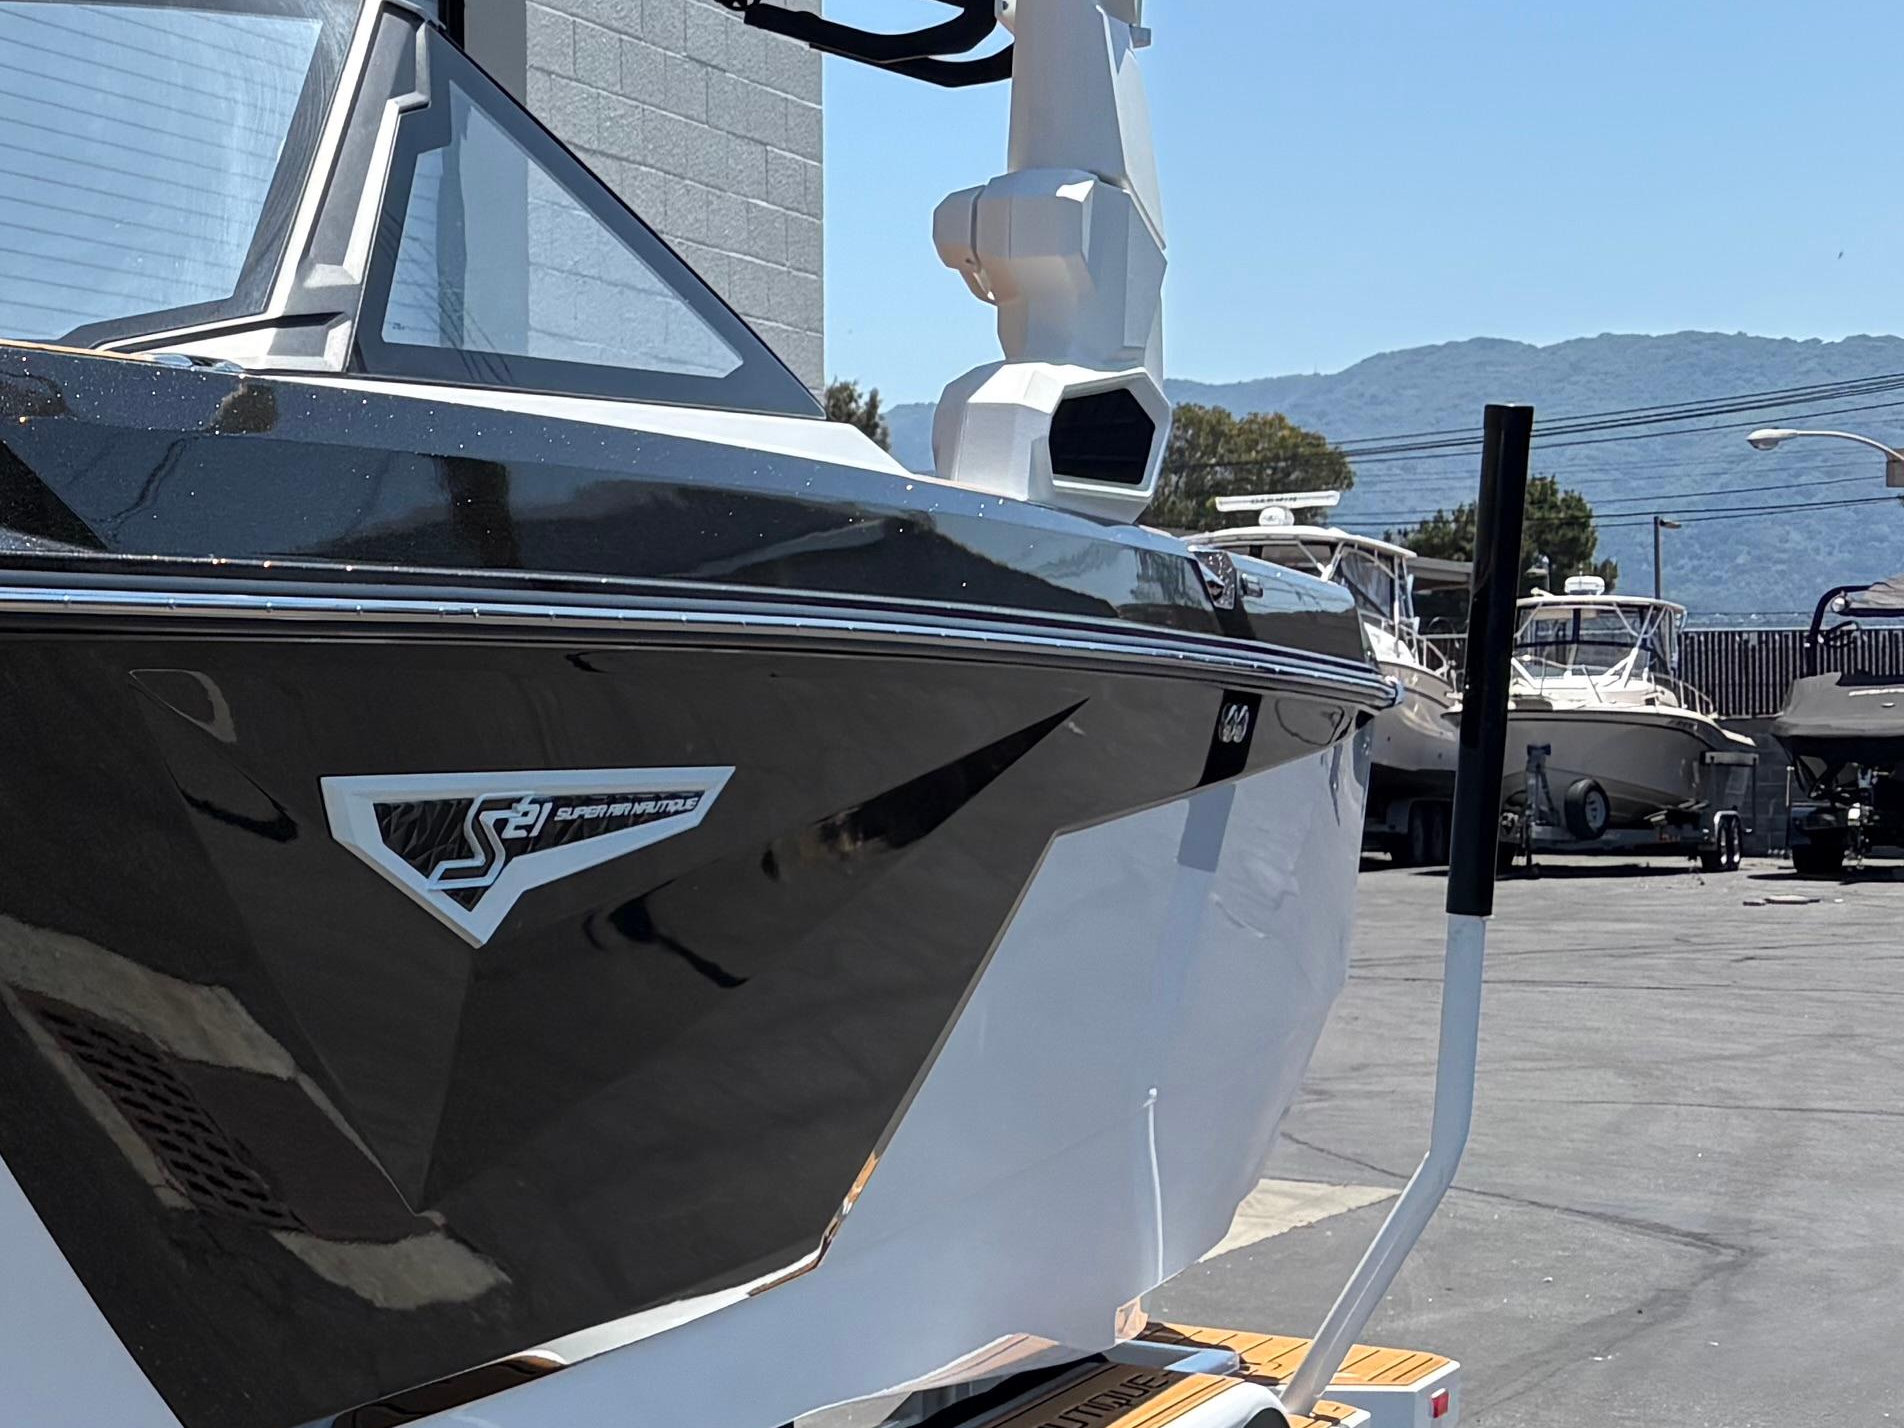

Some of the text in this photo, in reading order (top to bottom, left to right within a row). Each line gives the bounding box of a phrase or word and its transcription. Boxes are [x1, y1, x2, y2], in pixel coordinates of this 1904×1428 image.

[553, 797, 700, 822] SUPER AIR NAUTIQUE
